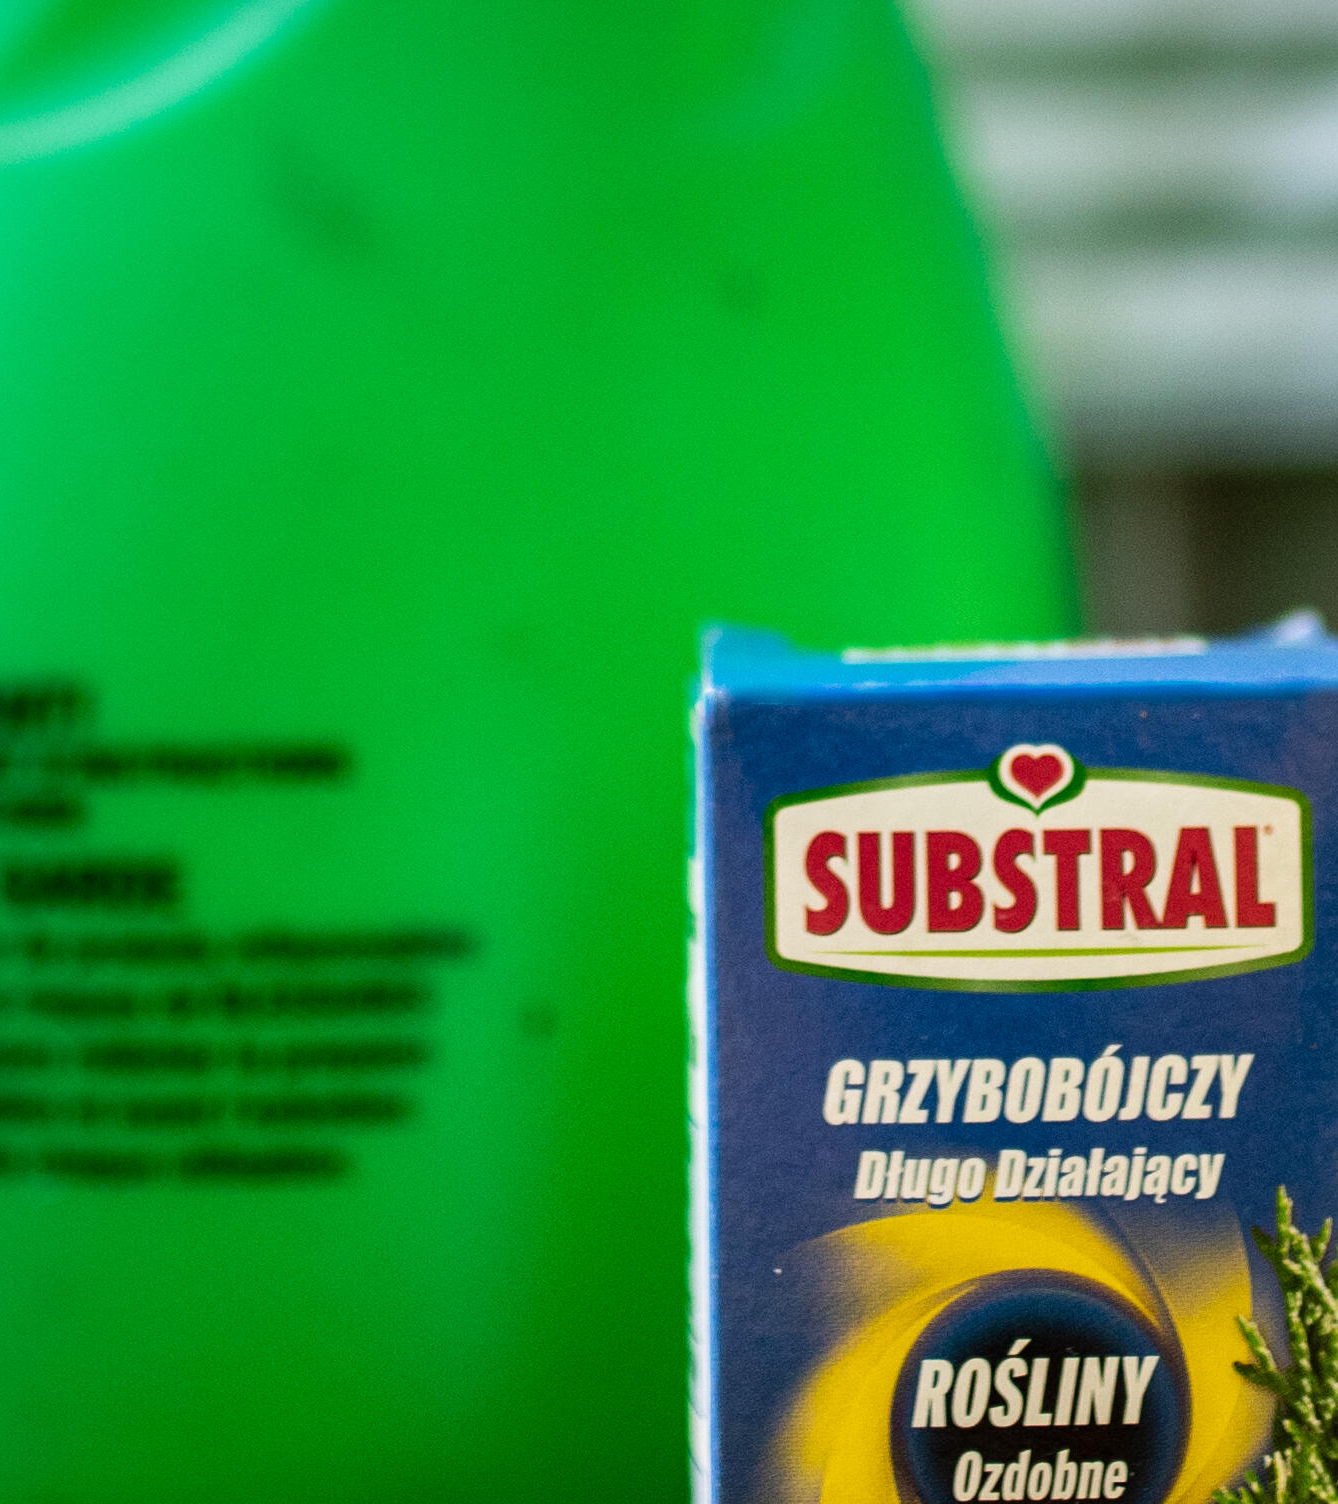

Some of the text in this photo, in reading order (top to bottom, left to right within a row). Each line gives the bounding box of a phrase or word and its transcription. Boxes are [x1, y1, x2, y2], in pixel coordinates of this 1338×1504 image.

[804, 826, 1278, 936] SUBSTRAL
[823, 1044, 1255, 1126] GRZYBOBÓJCZY
[853, 1147, 1225, 1206] Długo Działający
[910, 1339, 1161, 1429] ROŚLINY
[953, 1449, 1128, 1502] Ozdobne
